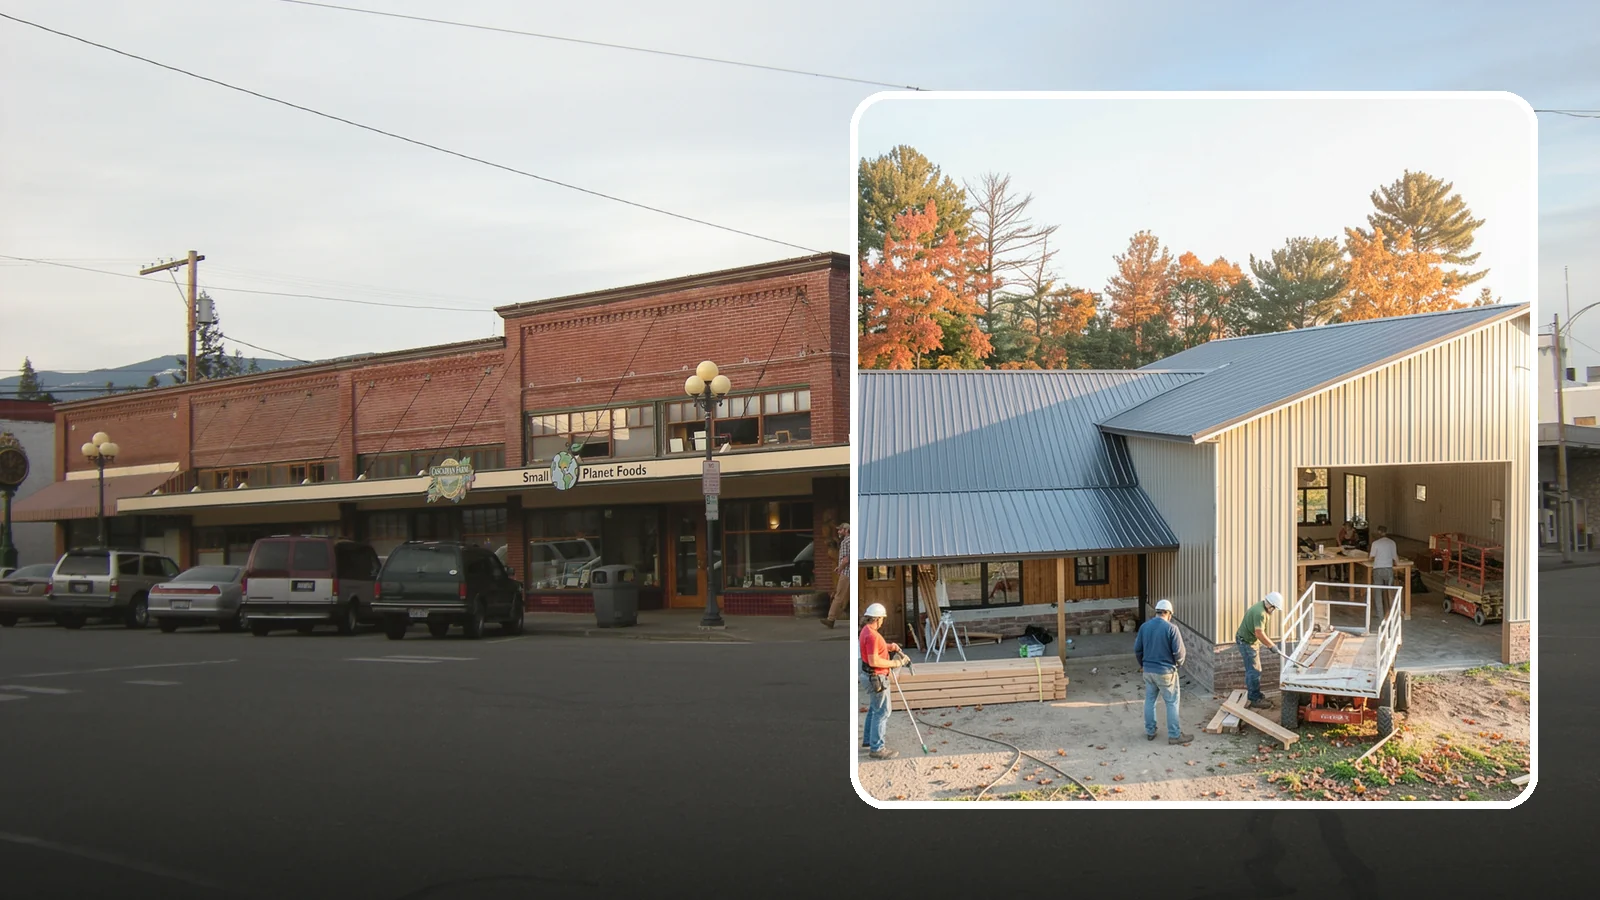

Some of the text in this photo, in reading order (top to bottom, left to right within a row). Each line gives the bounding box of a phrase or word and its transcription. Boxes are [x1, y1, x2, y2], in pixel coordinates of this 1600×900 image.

[523, 464, 647, 483] Small Planet Foods
